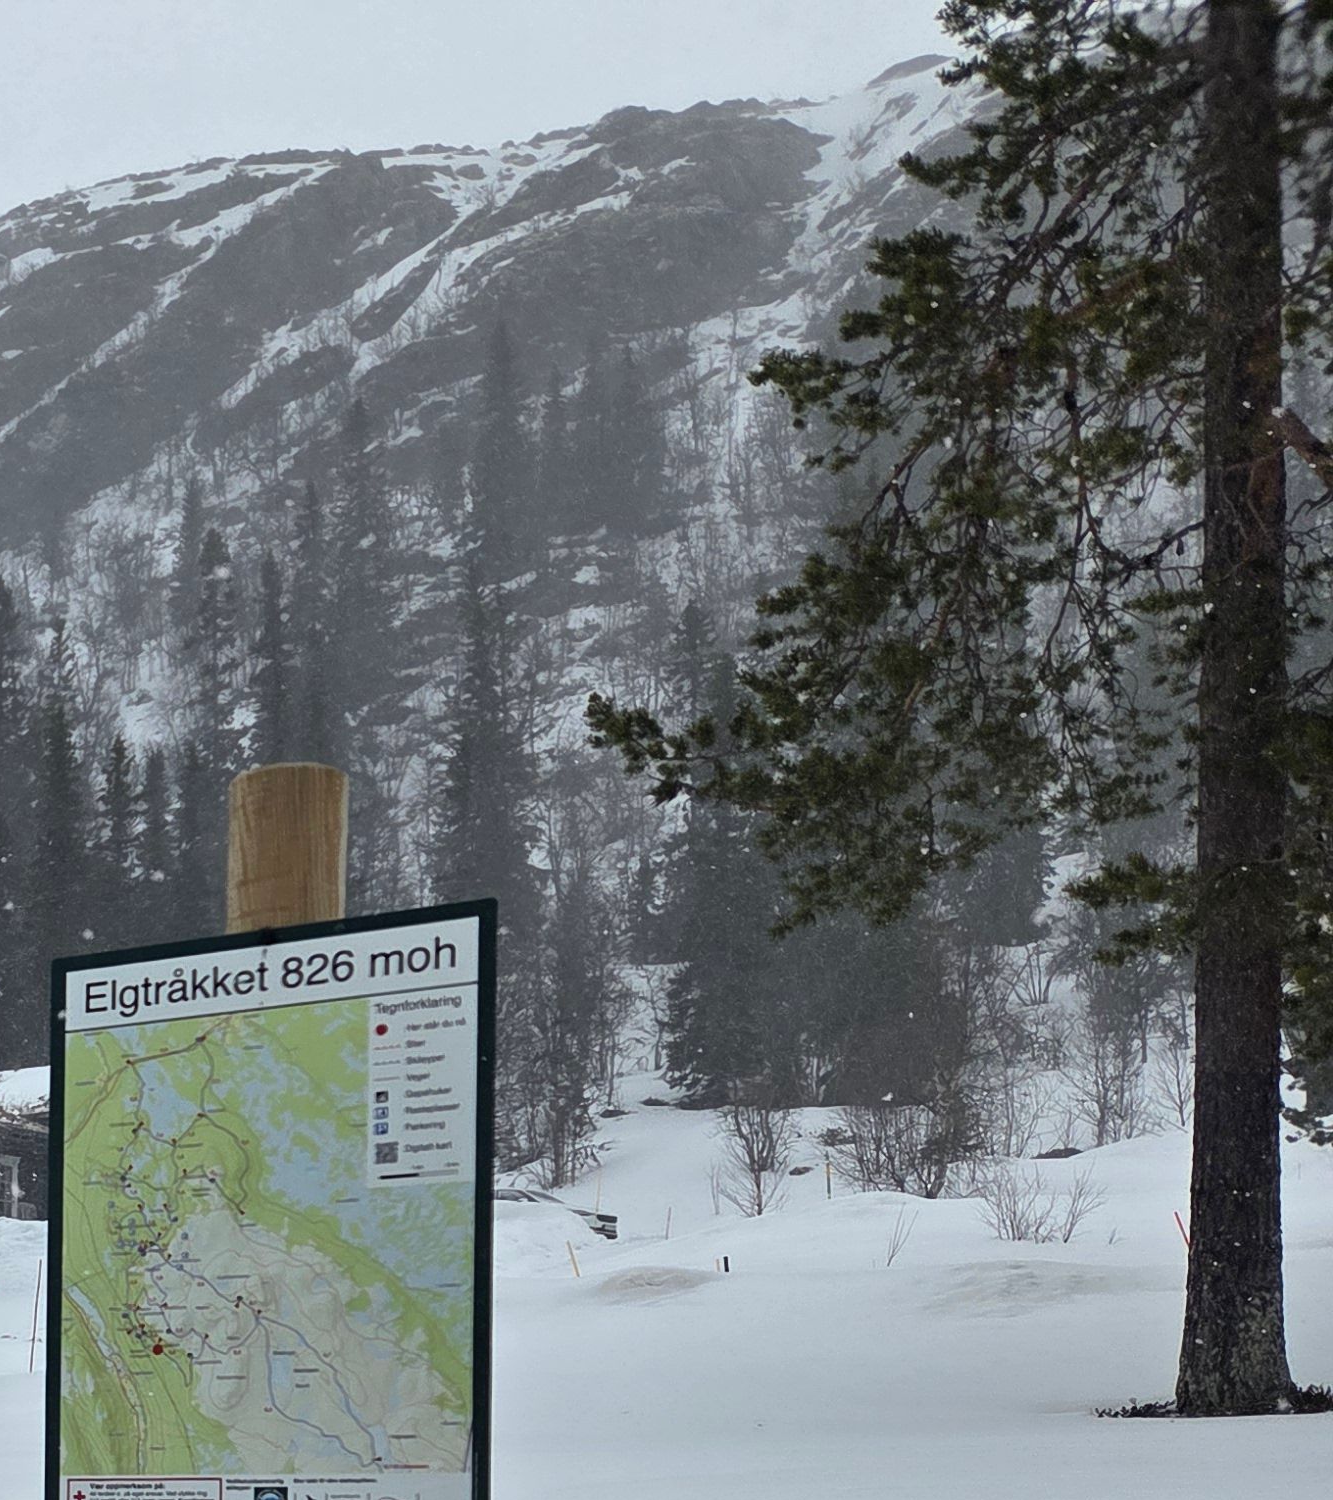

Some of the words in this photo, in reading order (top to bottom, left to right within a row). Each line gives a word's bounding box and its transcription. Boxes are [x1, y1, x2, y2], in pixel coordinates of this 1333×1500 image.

[85, 962, 269, 1017] Elgtråkket
[282, 950, 354, 988] 826
[370, 937, 457, 978] moh
